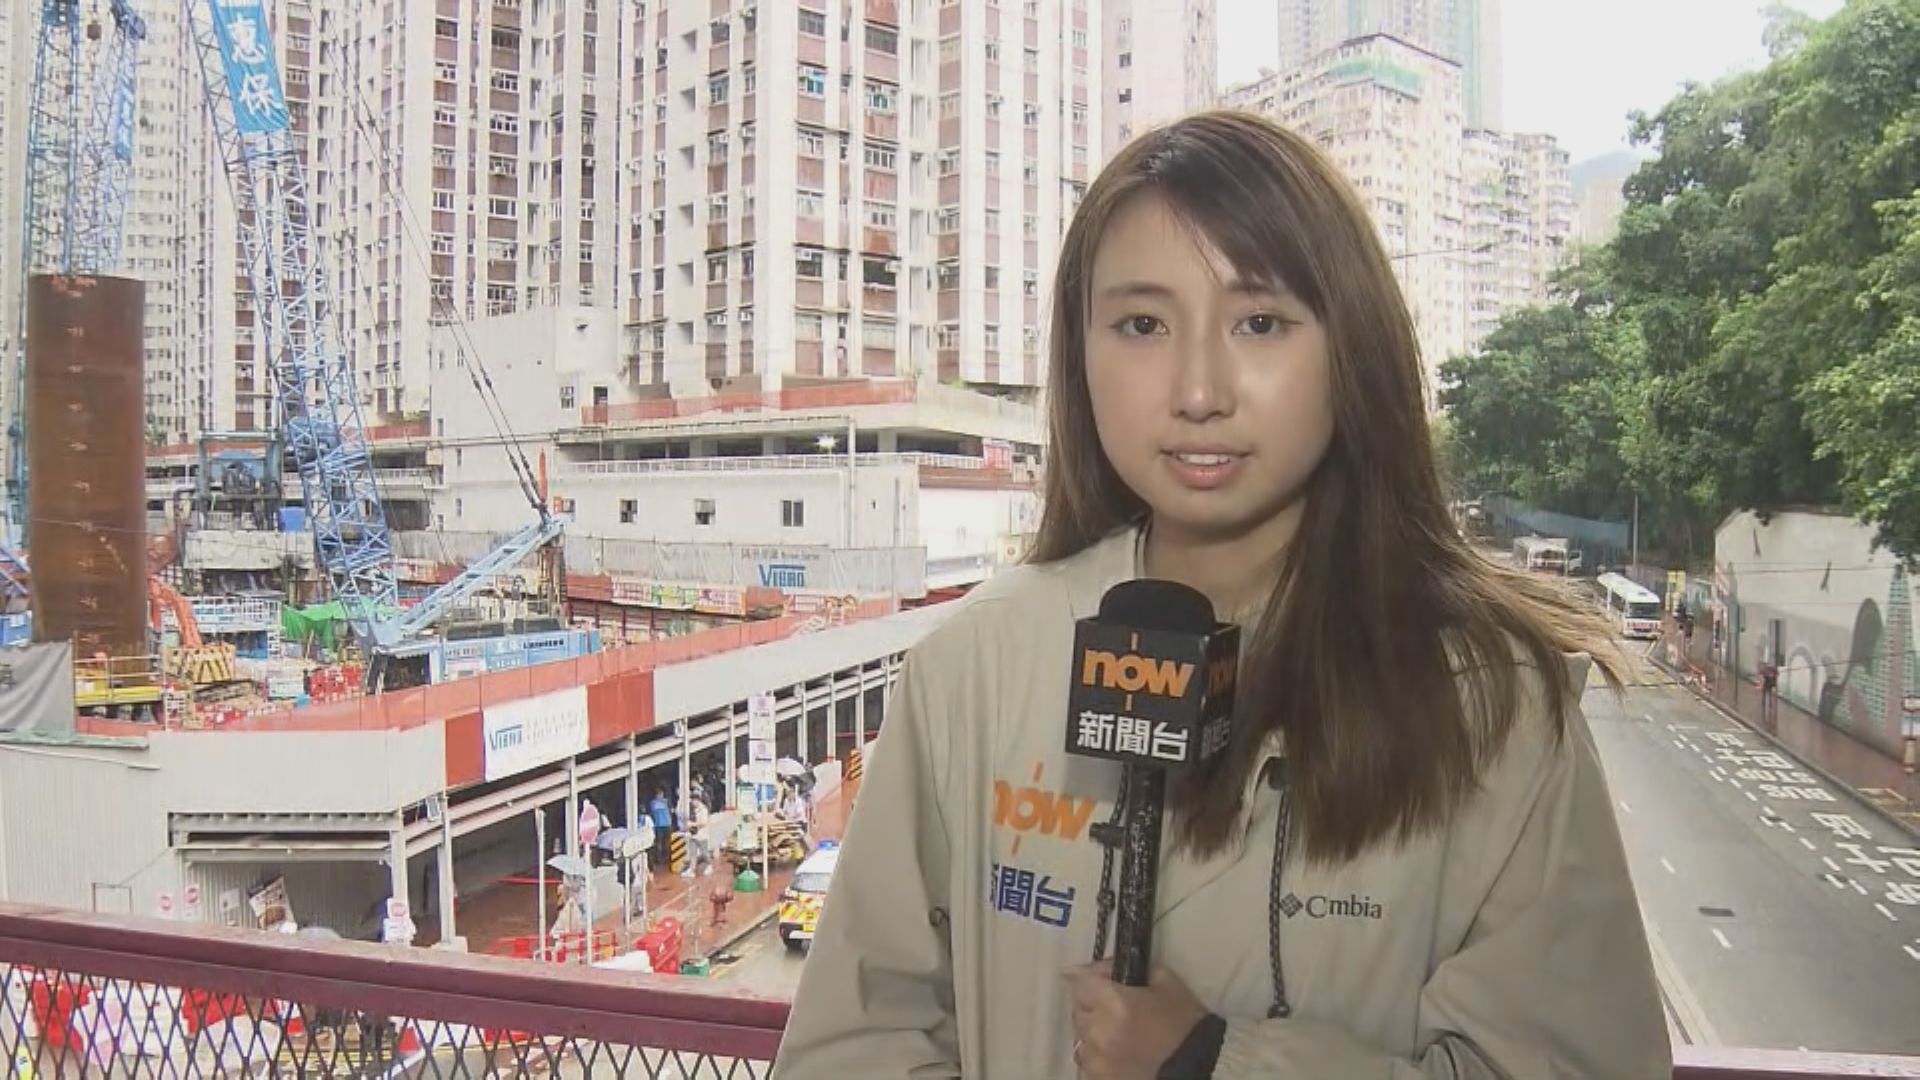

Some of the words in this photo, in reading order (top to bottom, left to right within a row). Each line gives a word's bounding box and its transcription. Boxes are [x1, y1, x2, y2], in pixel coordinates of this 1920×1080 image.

[227, 12, 282, 118] 惠保
[758, 564, 806, 587] VIBRO
[1082, 649, 1196, 698] now
[1076, 710, 1189, 761] 新聞台
[1736, 768, 1817, 784] STOP
[1758, 784, 1838, 802] BUS
[990, 862, 1075, 927] 聞台
